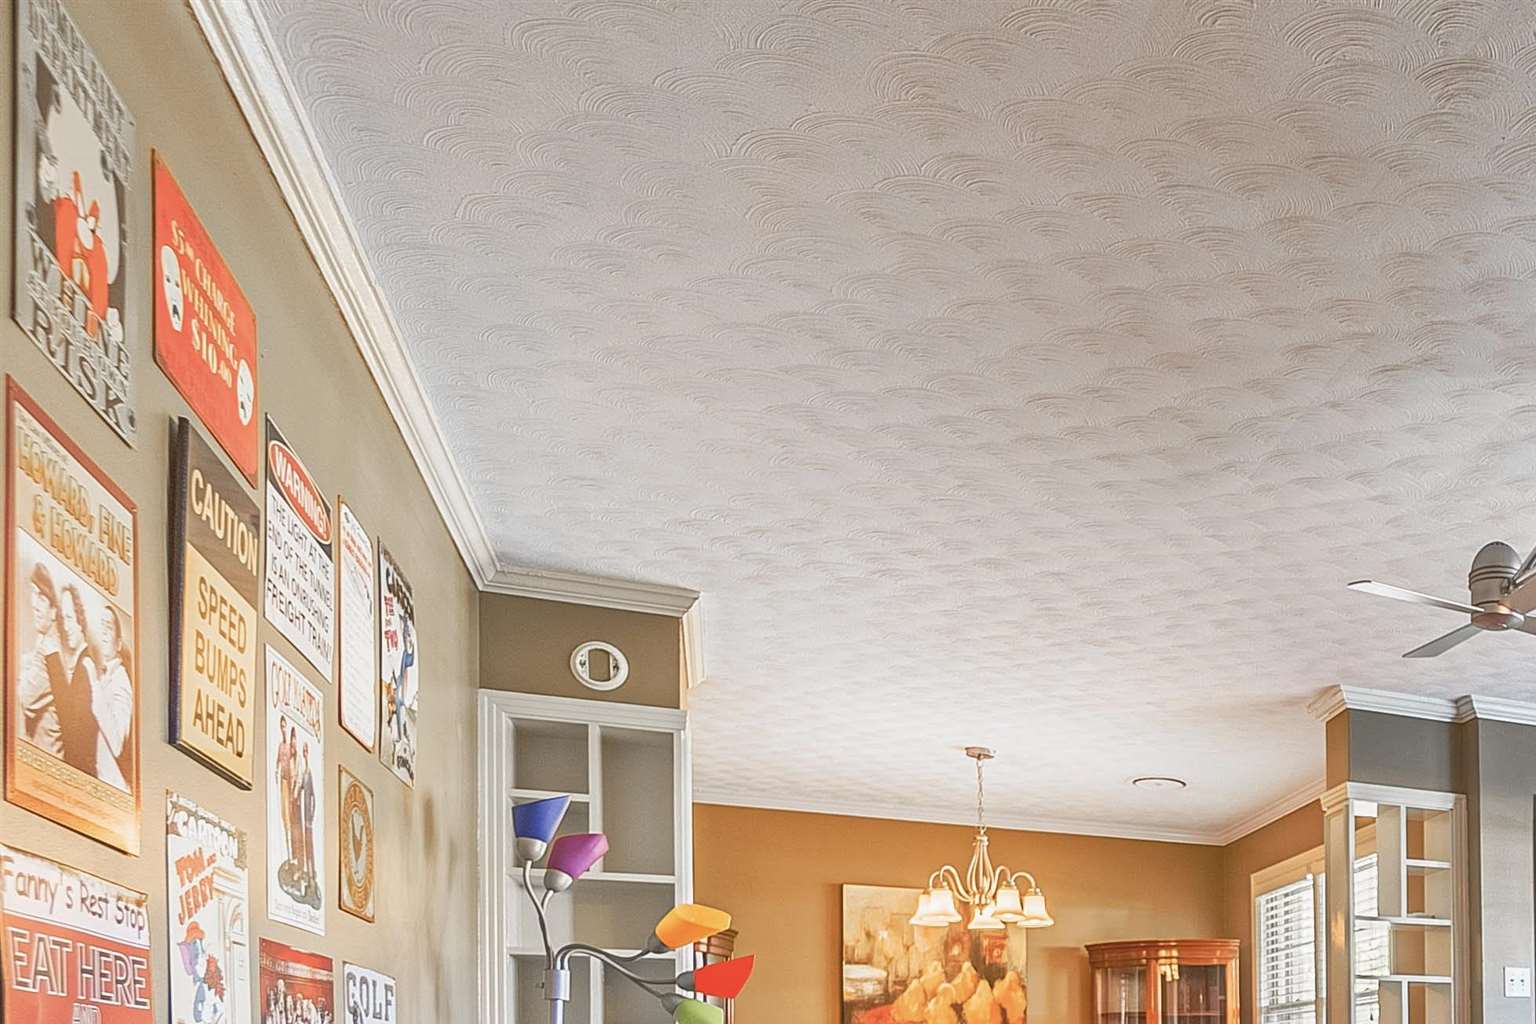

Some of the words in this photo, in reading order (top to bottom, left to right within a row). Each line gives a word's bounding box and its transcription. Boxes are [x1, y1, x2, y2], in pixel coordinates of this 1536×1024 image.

[30, 0, 124, 137] MPLAINT
[181, 267, 238, 371] WHINING
[195, 257, 236, 337] CHARGE
[31, 298, 125, 430] RISK
[32, 493, 46, 541] &
[50, 505, 119, 597] HOWARD
[98, 503, 132, 566] FINE
[191, 468, 258, 577] CAUTION
[267, 519, 282, 550] END
[284, 540, 294, 563] OF
[295, 552, 309, 583] THE
[271, 494, 286, 528] THE
[287, 514, 307, 554] LIGHT
[197, 575, 247, 656] SPEED
[266, 577, 306, 635] FREIGHT
[194, 628, 248, 711] BUMPS
[192, 687, 246, 760] AHEAD
[0, 855, 74, 914] Fanny's
[80, 880, 110, 920] Rest
[114, 901, 145, 940] Stop
[175, 847, 205, 888] TOM
[179, 875, 214, 925] JERRY
[7, 926, 73, 997] EAT
[76, 942, 151, 1010] HERE
[346, 972, 394, 1022] GOLF
